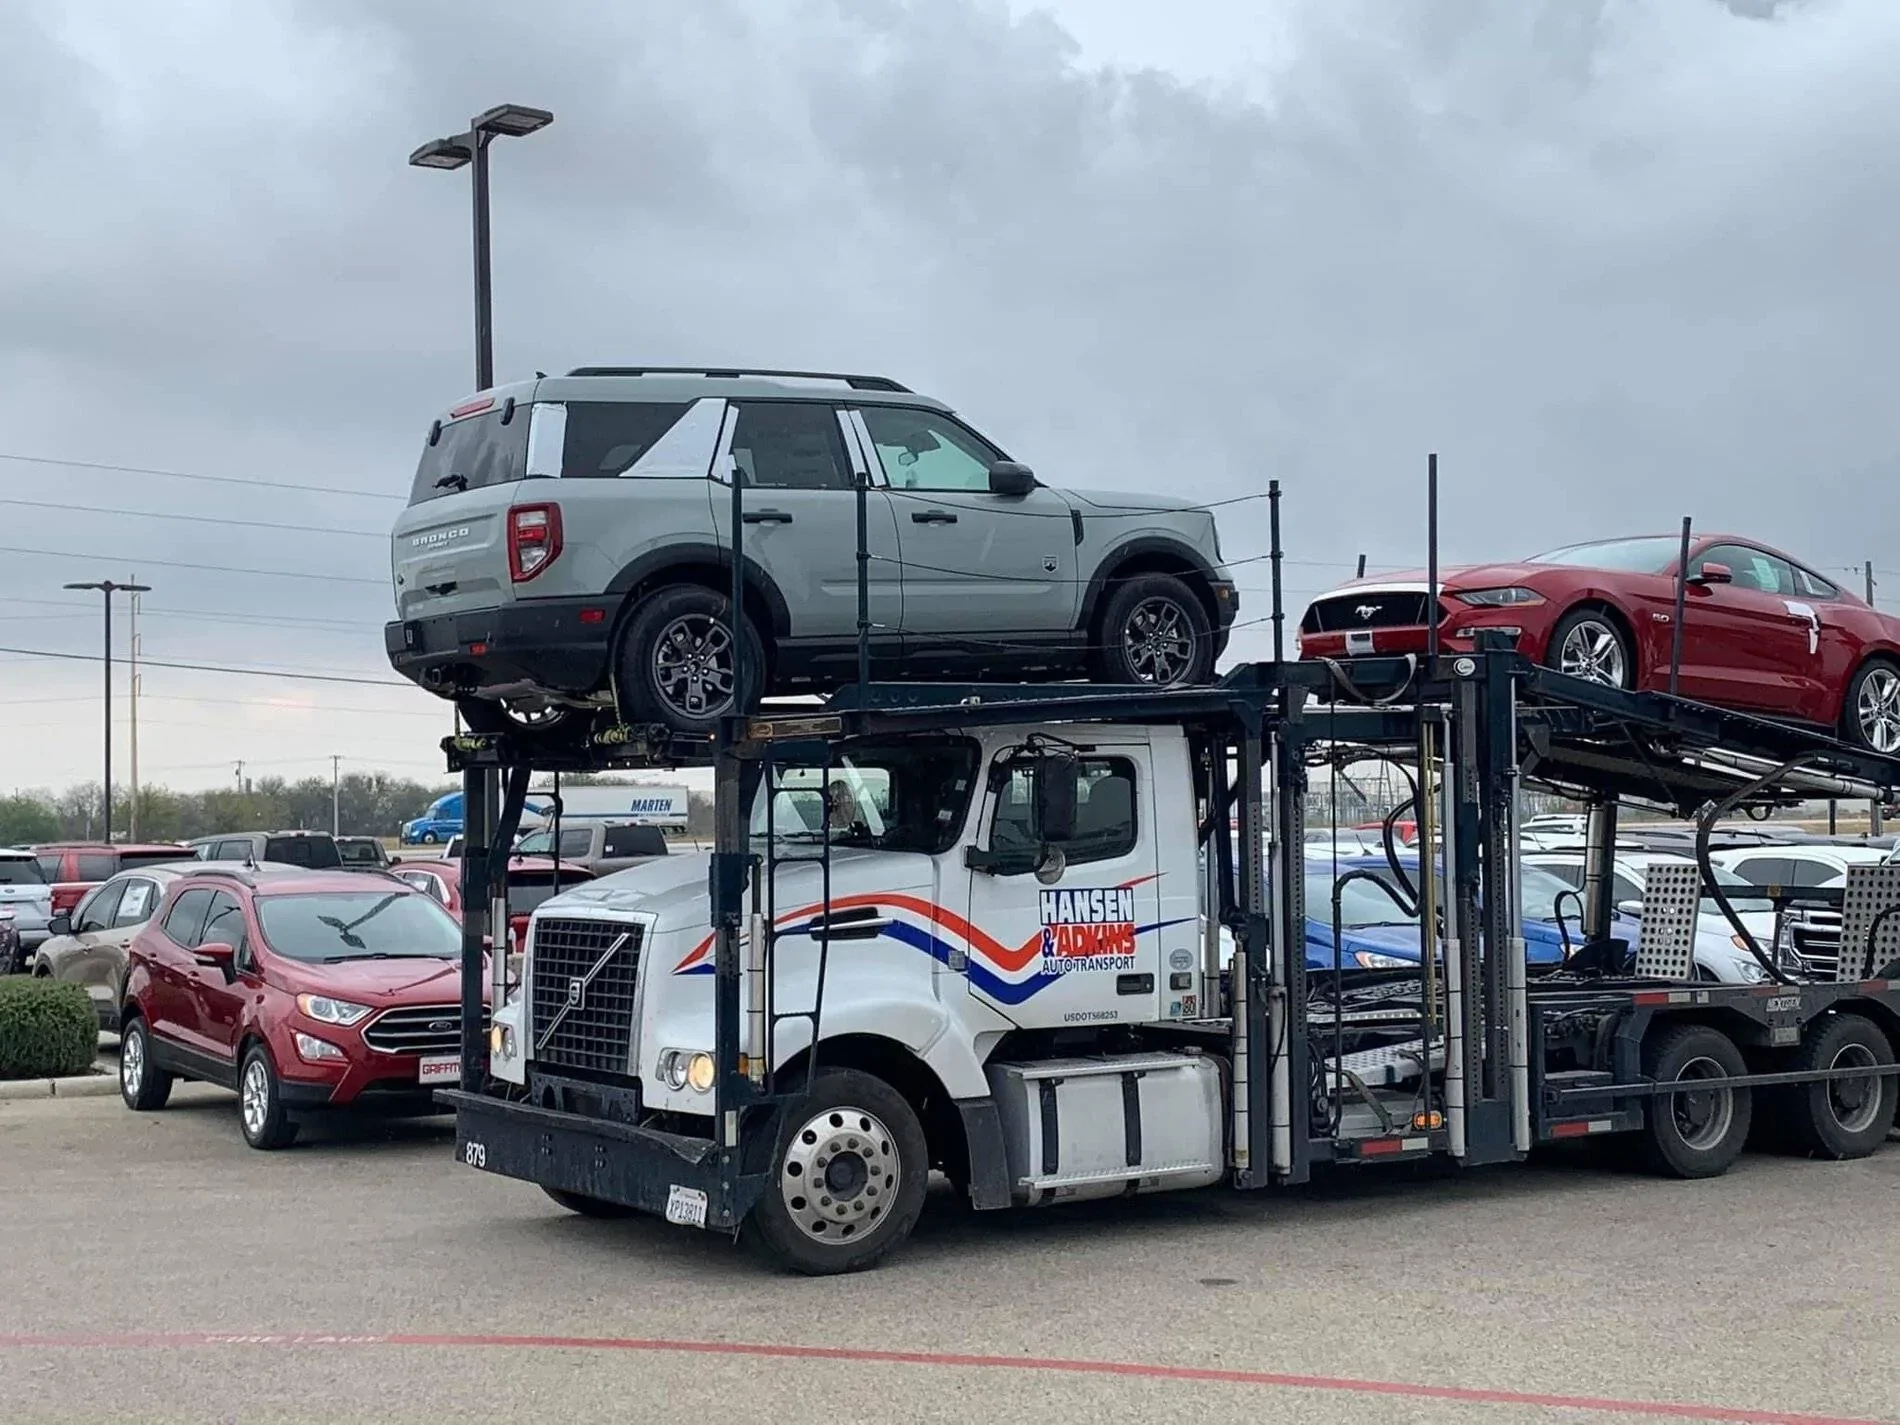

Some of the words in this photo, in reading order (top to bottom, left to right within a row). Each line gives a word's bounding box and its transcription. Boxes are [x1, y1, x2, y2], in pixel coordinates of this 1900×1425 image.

[412, 527, 469, 546] BRONCO
[631, 799, 672, 811] MARTEN
[1040, 888, 1133, 924] HANSEN
[1042, 927, 1055, 958] &
[1056, 924, 1135, 957] ADKINS
[1074, 956, 1135, 972] TRANSPORT
[466, 1141, 486, 1168] 879
